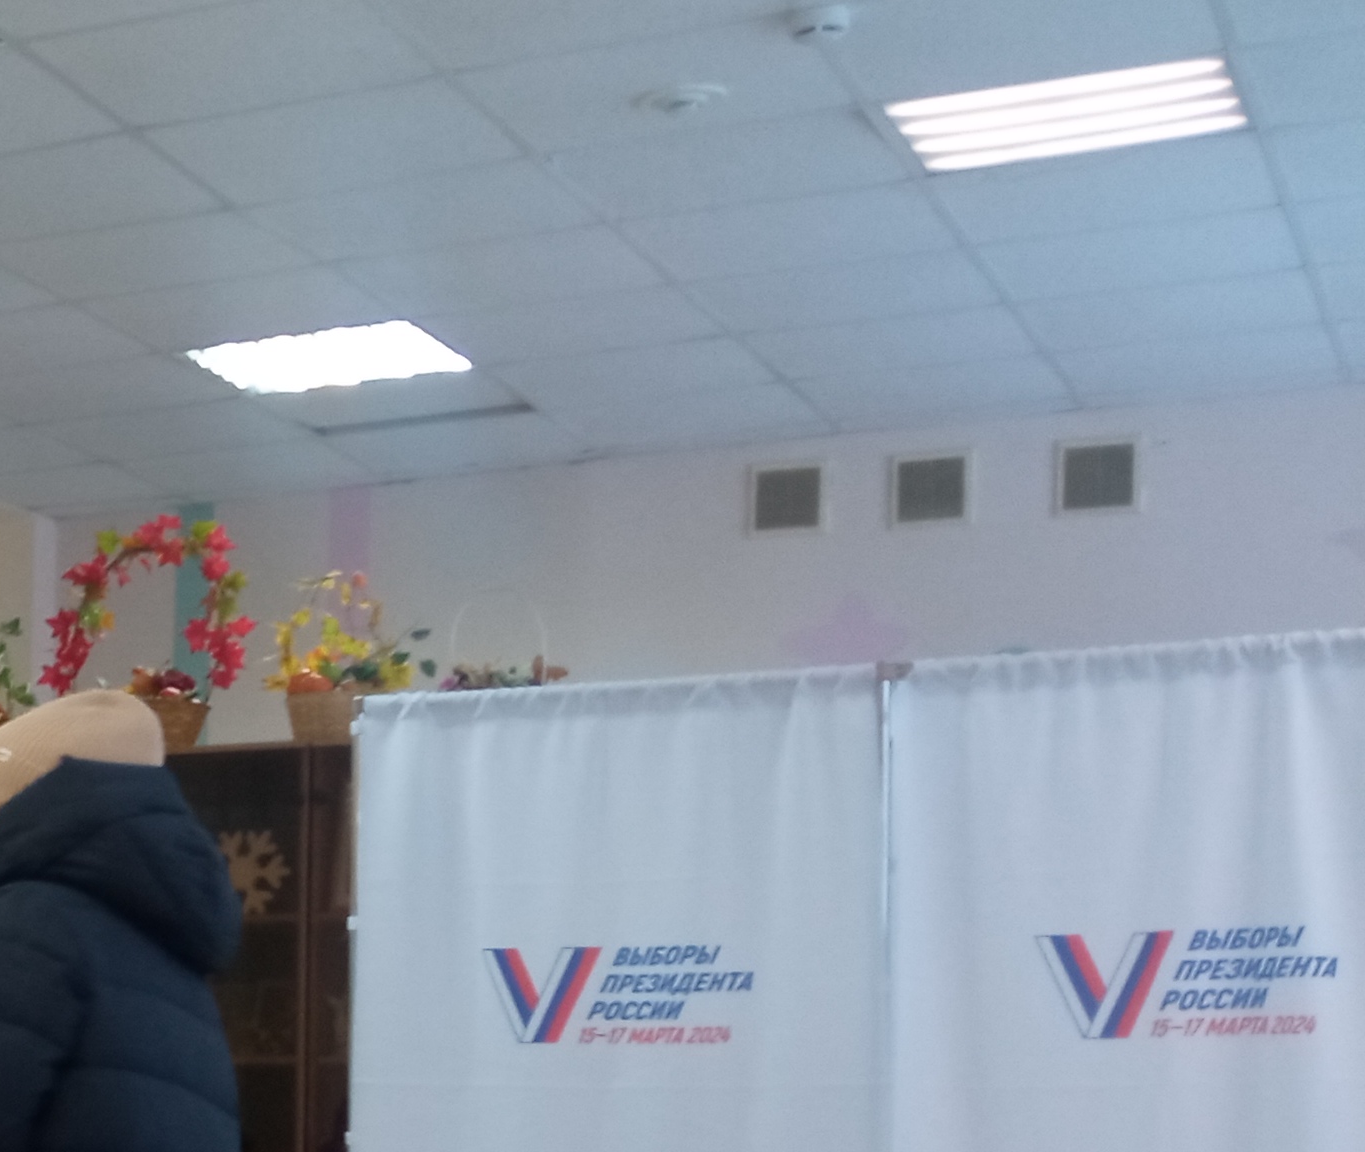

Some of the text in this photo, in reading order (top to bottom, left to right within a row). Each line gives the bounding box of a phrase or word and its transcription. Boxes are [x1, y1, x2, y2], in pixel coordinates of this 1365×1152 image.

[1187, 926, 1305, 952] ВЫБОРЫ
[612, 944, 722, 967] ВЫБОРЫ
[1173, 956, 1339, 982] ПРЕЗИДЕНТА
[599, 970, 755, 996] ПРЕЗИДЕНТА
[587, 999, 686, 1021] РОССИИ
[1159, 987, 1269, 1012] РОССИИ
[628, 1027, 685, 1044] МАРТА
[687, 1026, 732, 1044] 2024
[1206, 1016, 1269, 1037] МАРТА
[1270, 1015, 1317, 1036] 2024
